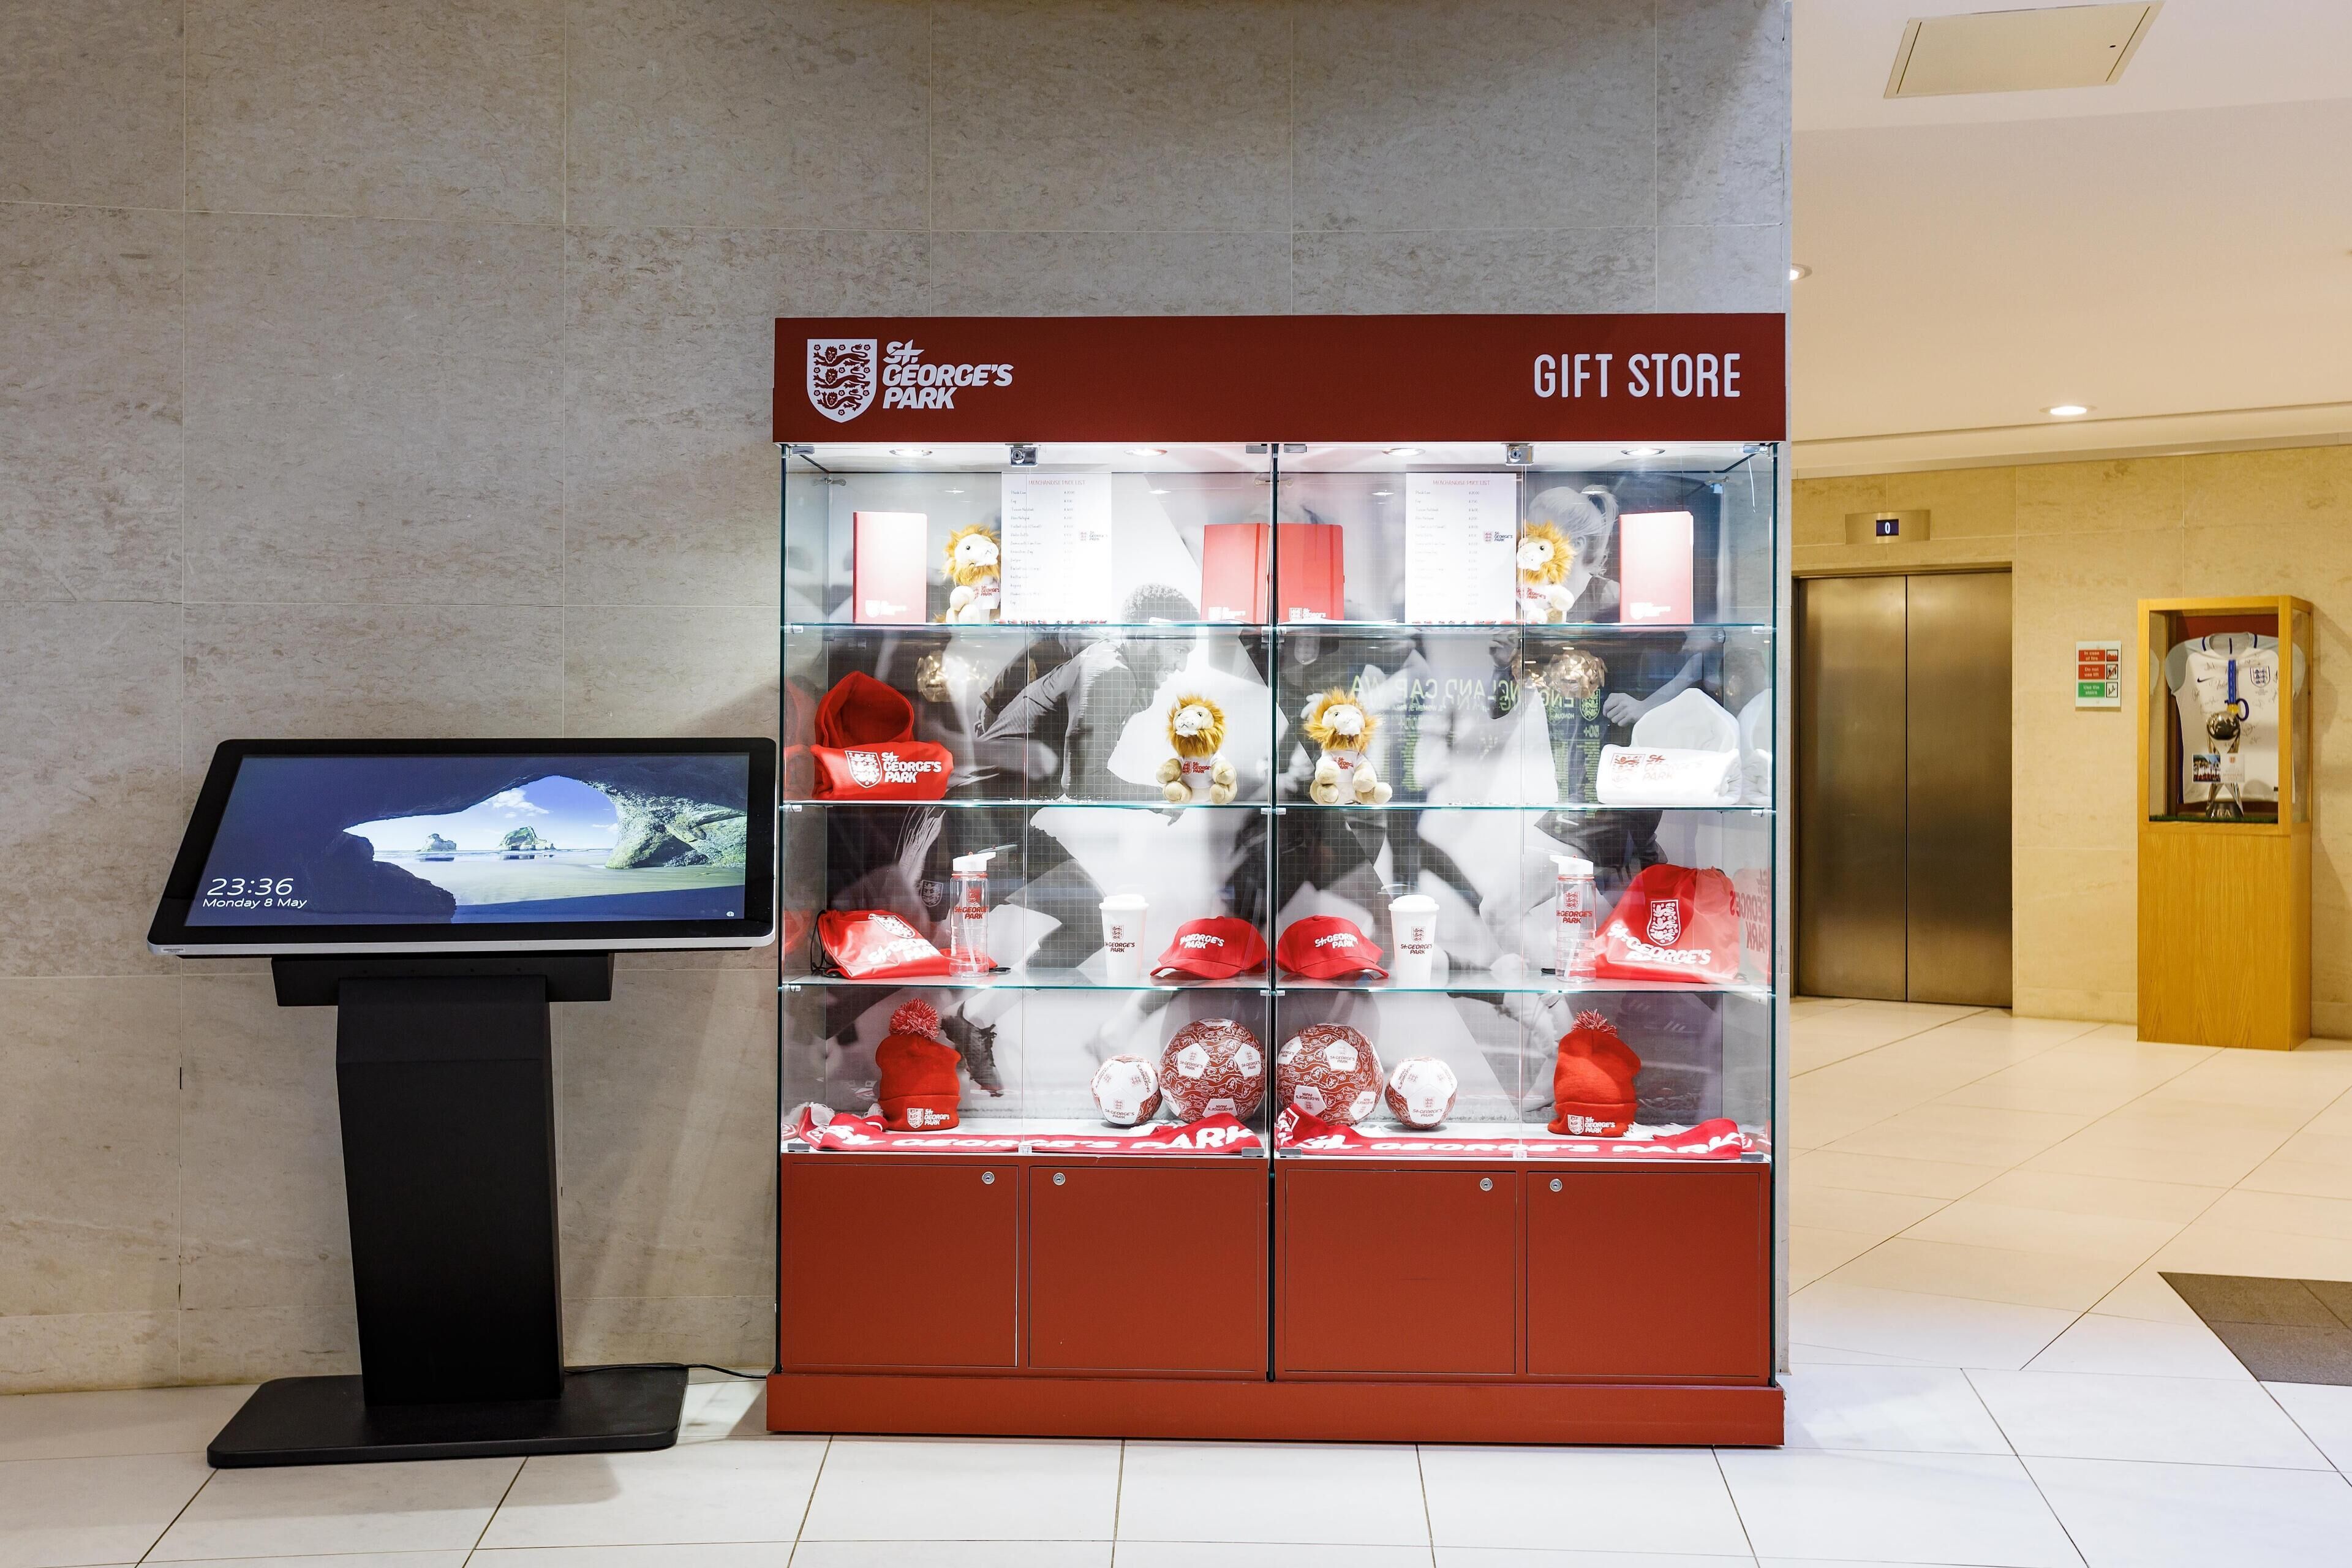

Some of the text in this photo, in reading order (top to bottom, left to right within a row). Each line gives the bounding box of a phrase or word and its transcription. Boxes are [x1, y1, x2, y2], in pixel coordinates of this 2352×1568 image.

[883, 364, 1014, 386] GEORGE'S
[1534, 353, 1741, 398] GIFT STORE
[883, 386, 957, 409] PARK
[1885, 522, 1890, 534] 0
[883, 761, 942, 772] GEORGE'S
[884, 772, 918, 783] PARK
[207, 878, 294, 895] 23:36
[203, 898, 307, 909] Monday 8 May
[1626, 937, 1712, 965] GEORGE'S
